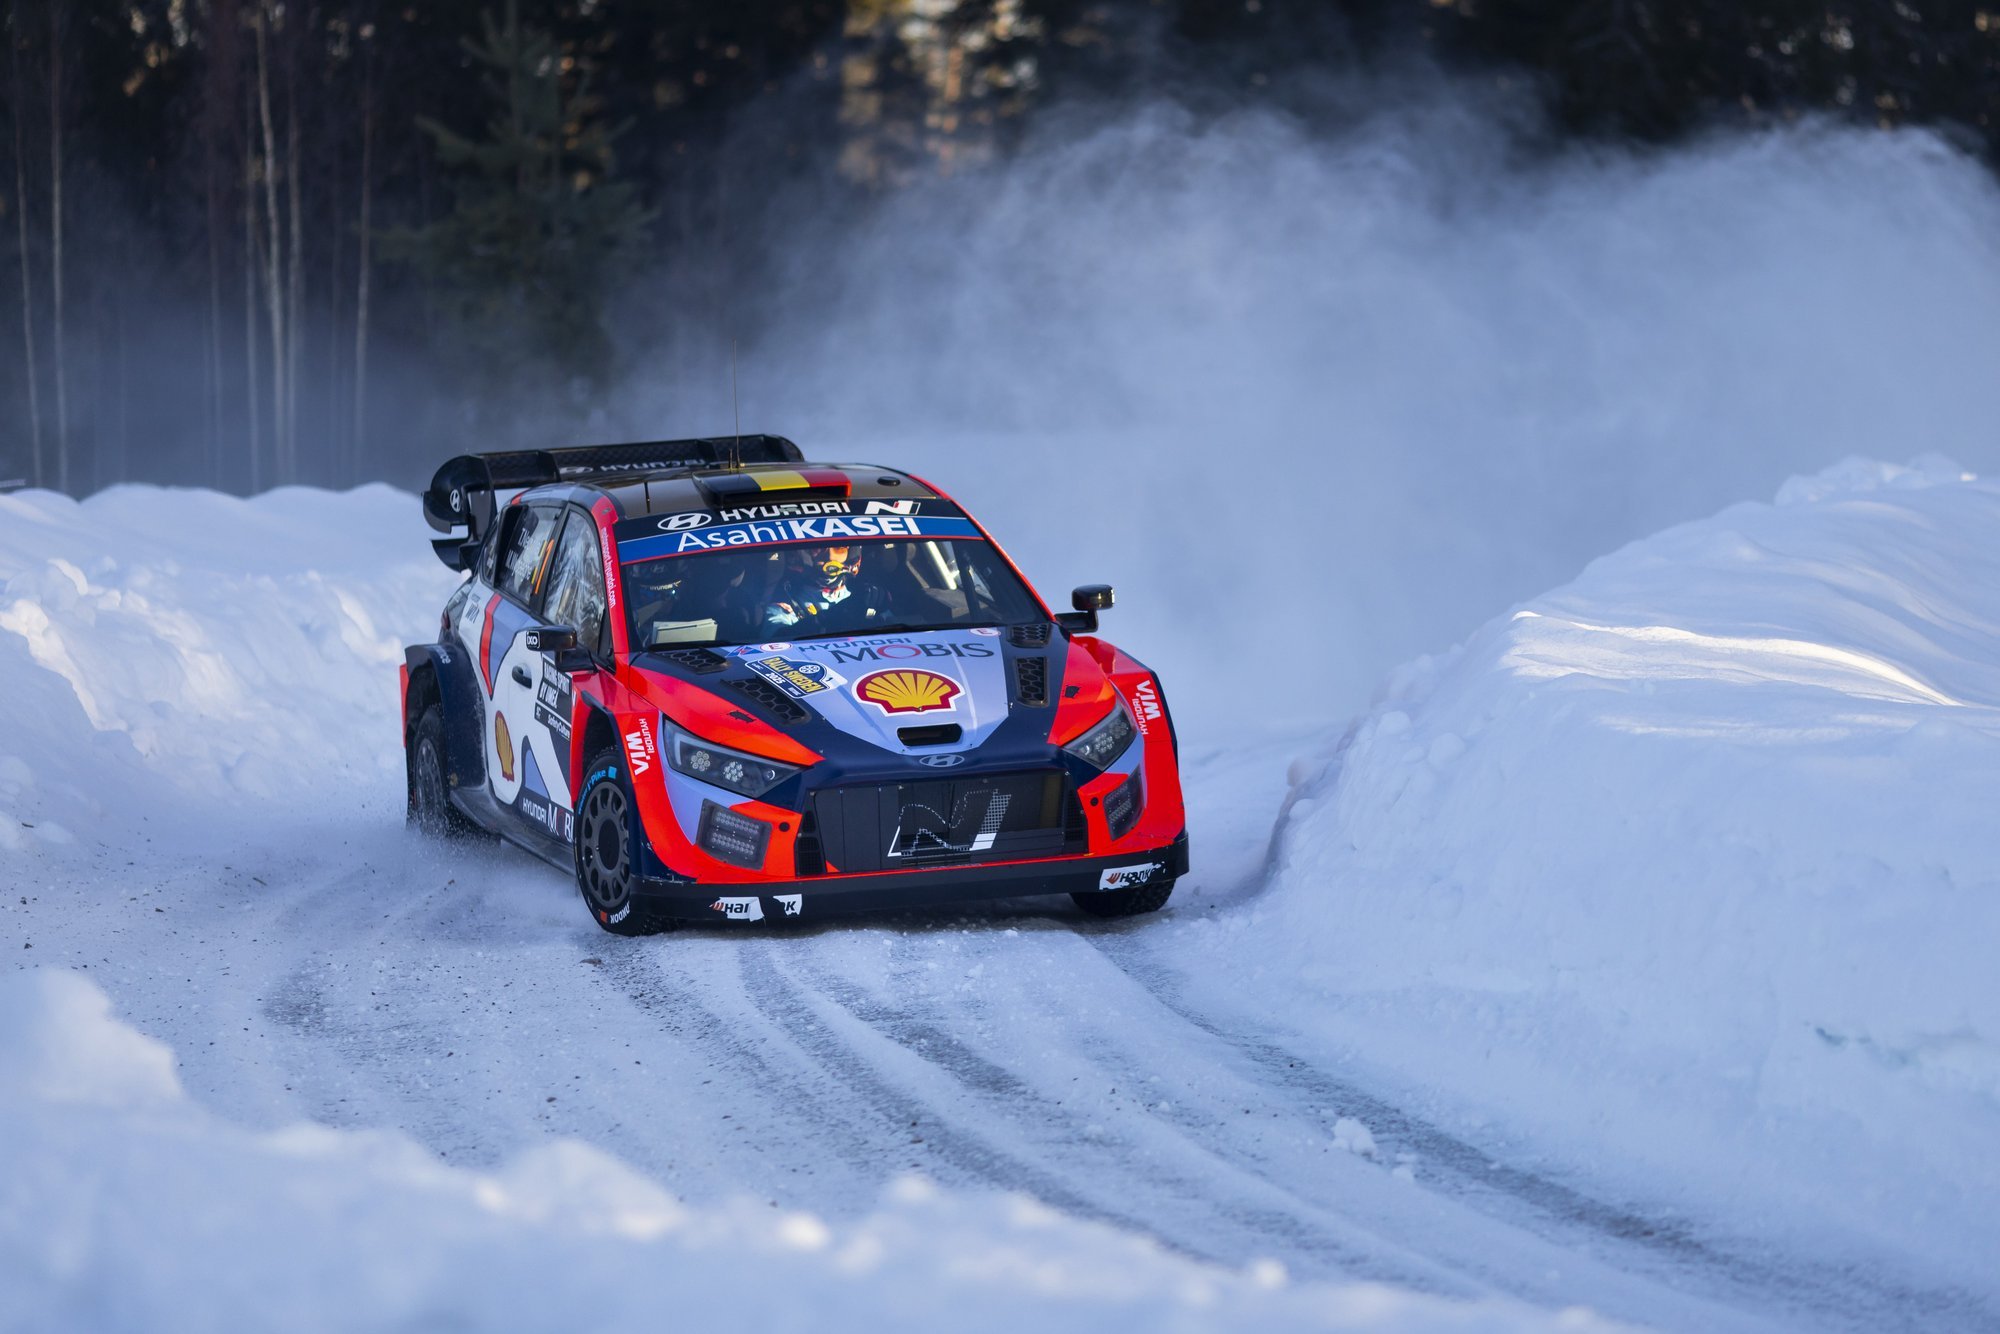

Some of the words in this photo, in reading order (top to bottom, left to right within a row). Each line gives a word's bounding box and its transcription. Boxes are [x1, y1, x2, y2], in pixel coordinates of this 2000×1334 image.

[719, 502, 850, 522] HYUNDAI
[798, 637, 912, 653] HYUNDAI
[832, 643, 995, 664] MOBIS
[762, 656, 794, 673] RALLY
[783, 669, 825, 693] SWEDEN
[765, 672, 786, 685] 2025
[1131, 698, 1149, 735] HYUNDAI
[639, 717, 655, 754] HYUNDAI
[522, 797, 547, 824] HYUNDAI
